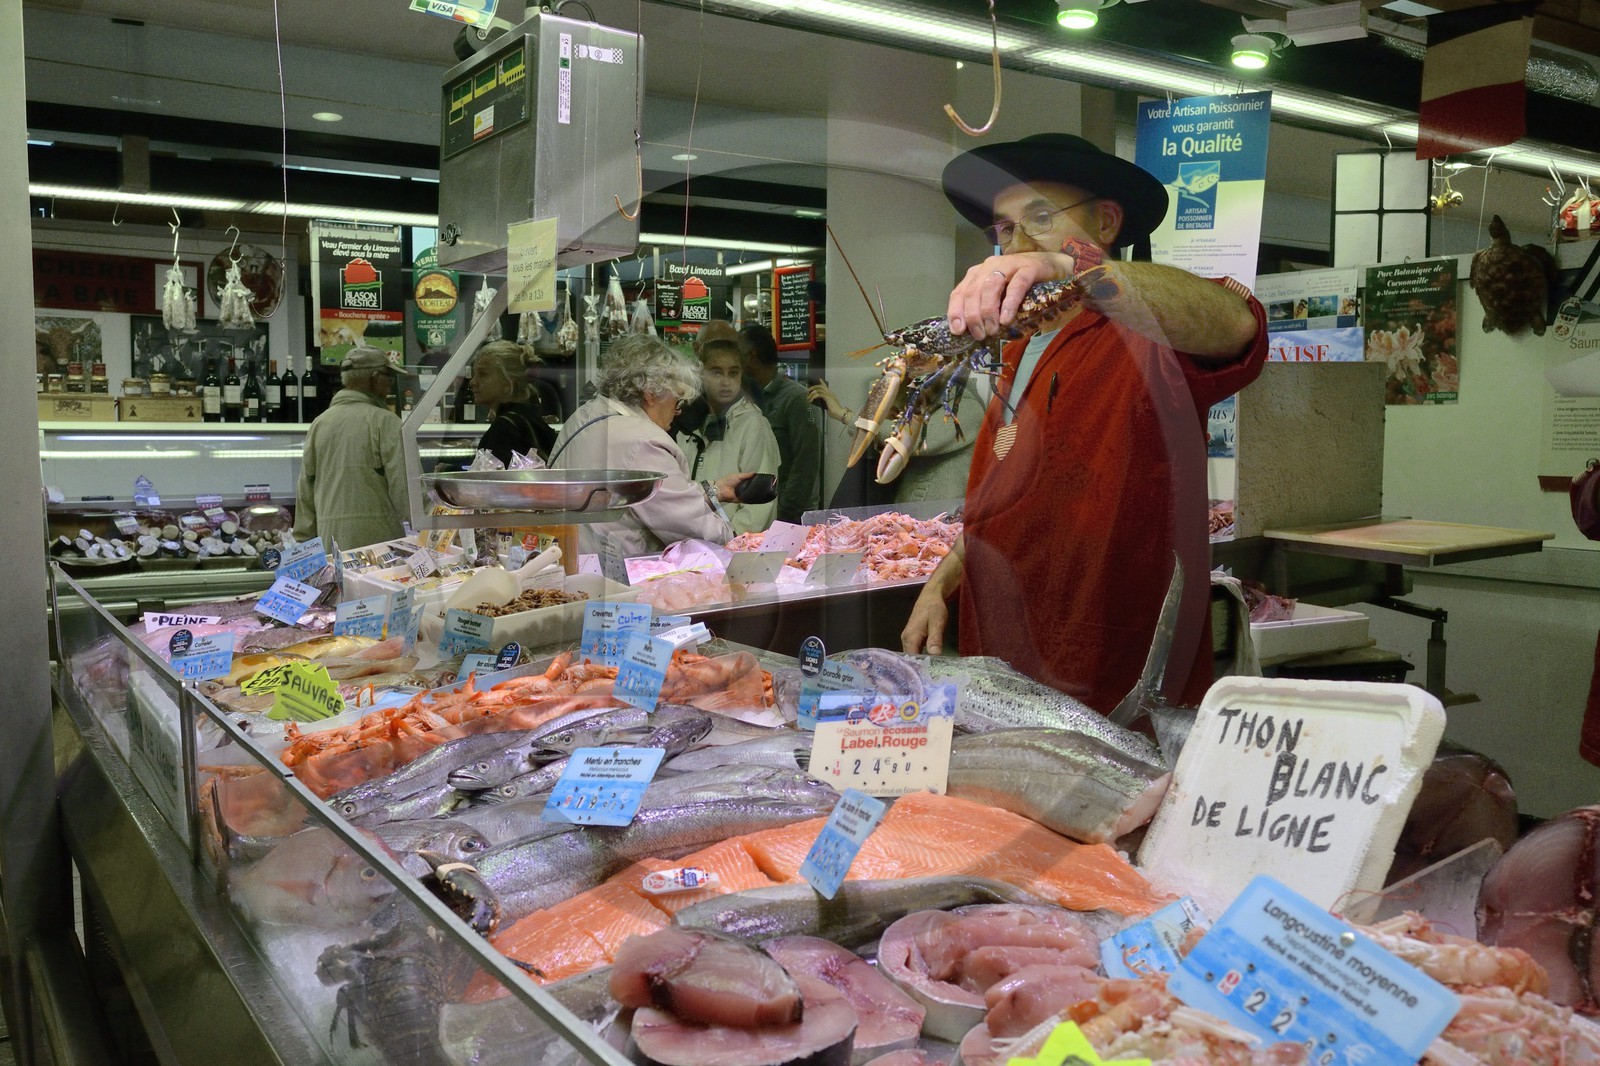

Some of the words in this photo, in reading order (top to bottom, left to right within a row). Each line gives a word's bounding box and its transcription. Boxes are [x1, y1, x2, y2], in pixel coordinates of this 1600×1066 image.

[430, 2, 454, 14] VISA
[1147, 108, 1171, 119] Votre
[1173, 104, 1207, 117] Artisan
[1209, 99, 1265, 114] Poissonnier
[1172, 123, 1194, 133] vous
[1196, 118, 1235, 134] garantit
[1162, 137, 1177, 156] la
[1181, 133, 1243, 157] Qualité
[1178, 214, 1213, 222] POISSONNIER
[321, 240, 337, 249] Veau
[338, 241, 362, 251] Fermier
[363, 243, 371, 251] du
[372, 244, 400, 253] Limousin
[333, 249, 349, 257] élevé
[350, 250, 365, 258] sous
[366, 250, 373, 258] la
[373, 251, 390, 259] mère
[669, 264, 688, 276] Bœuf
[690, 265, 723, 276] Limousin
[1377, 270, 1393, 279] Parc
[1394, 266, 1432, 277] Botanique
[1433, 264, 1444, 272] de
[1387, 277, 1429, 287] Cornouaille
[345, 291, 377, 300] BLASON
[344, 299, 379, 308] PRESTIGE
[682, 305, 707, 313] BLASON
[338, 311, 367, 319] Boucherie
[367, 312, 386, 321] agréée
[682, 312, 708, 320] PRESTIGE
[592, 609, 613, 618] Crevettes
[823, 669, 842, 680] Dorade
[281, 670, 342, 716] SAUVAGE
[843, 728, 880, 737] Saumon
[882, 725, 928, 735] écossais
[1218, 707, 1304, 754] THON
[841, 737, 878, 750] Label
[882, 736, 928, 750] Rouge
[584, 757, 602, 765] Merlu
[613, 757, 642, 765] tranches
[1266, 751, 1388, 807] BLANC
[1191, 795, 1226, 828] DE
[1235, 805, 1336, 853] LIGNE
[1263, 899, 1346, 960] Langoustine
[1346, 956, 1418, 1008] moyenne
[1263, 935, 1286, 956] Pêché
[1286, 953, 1298, 962] en
[1298, 961, 1340, 992] Atlantique
[1340, 989, 1378, 1017] Nord-Est
